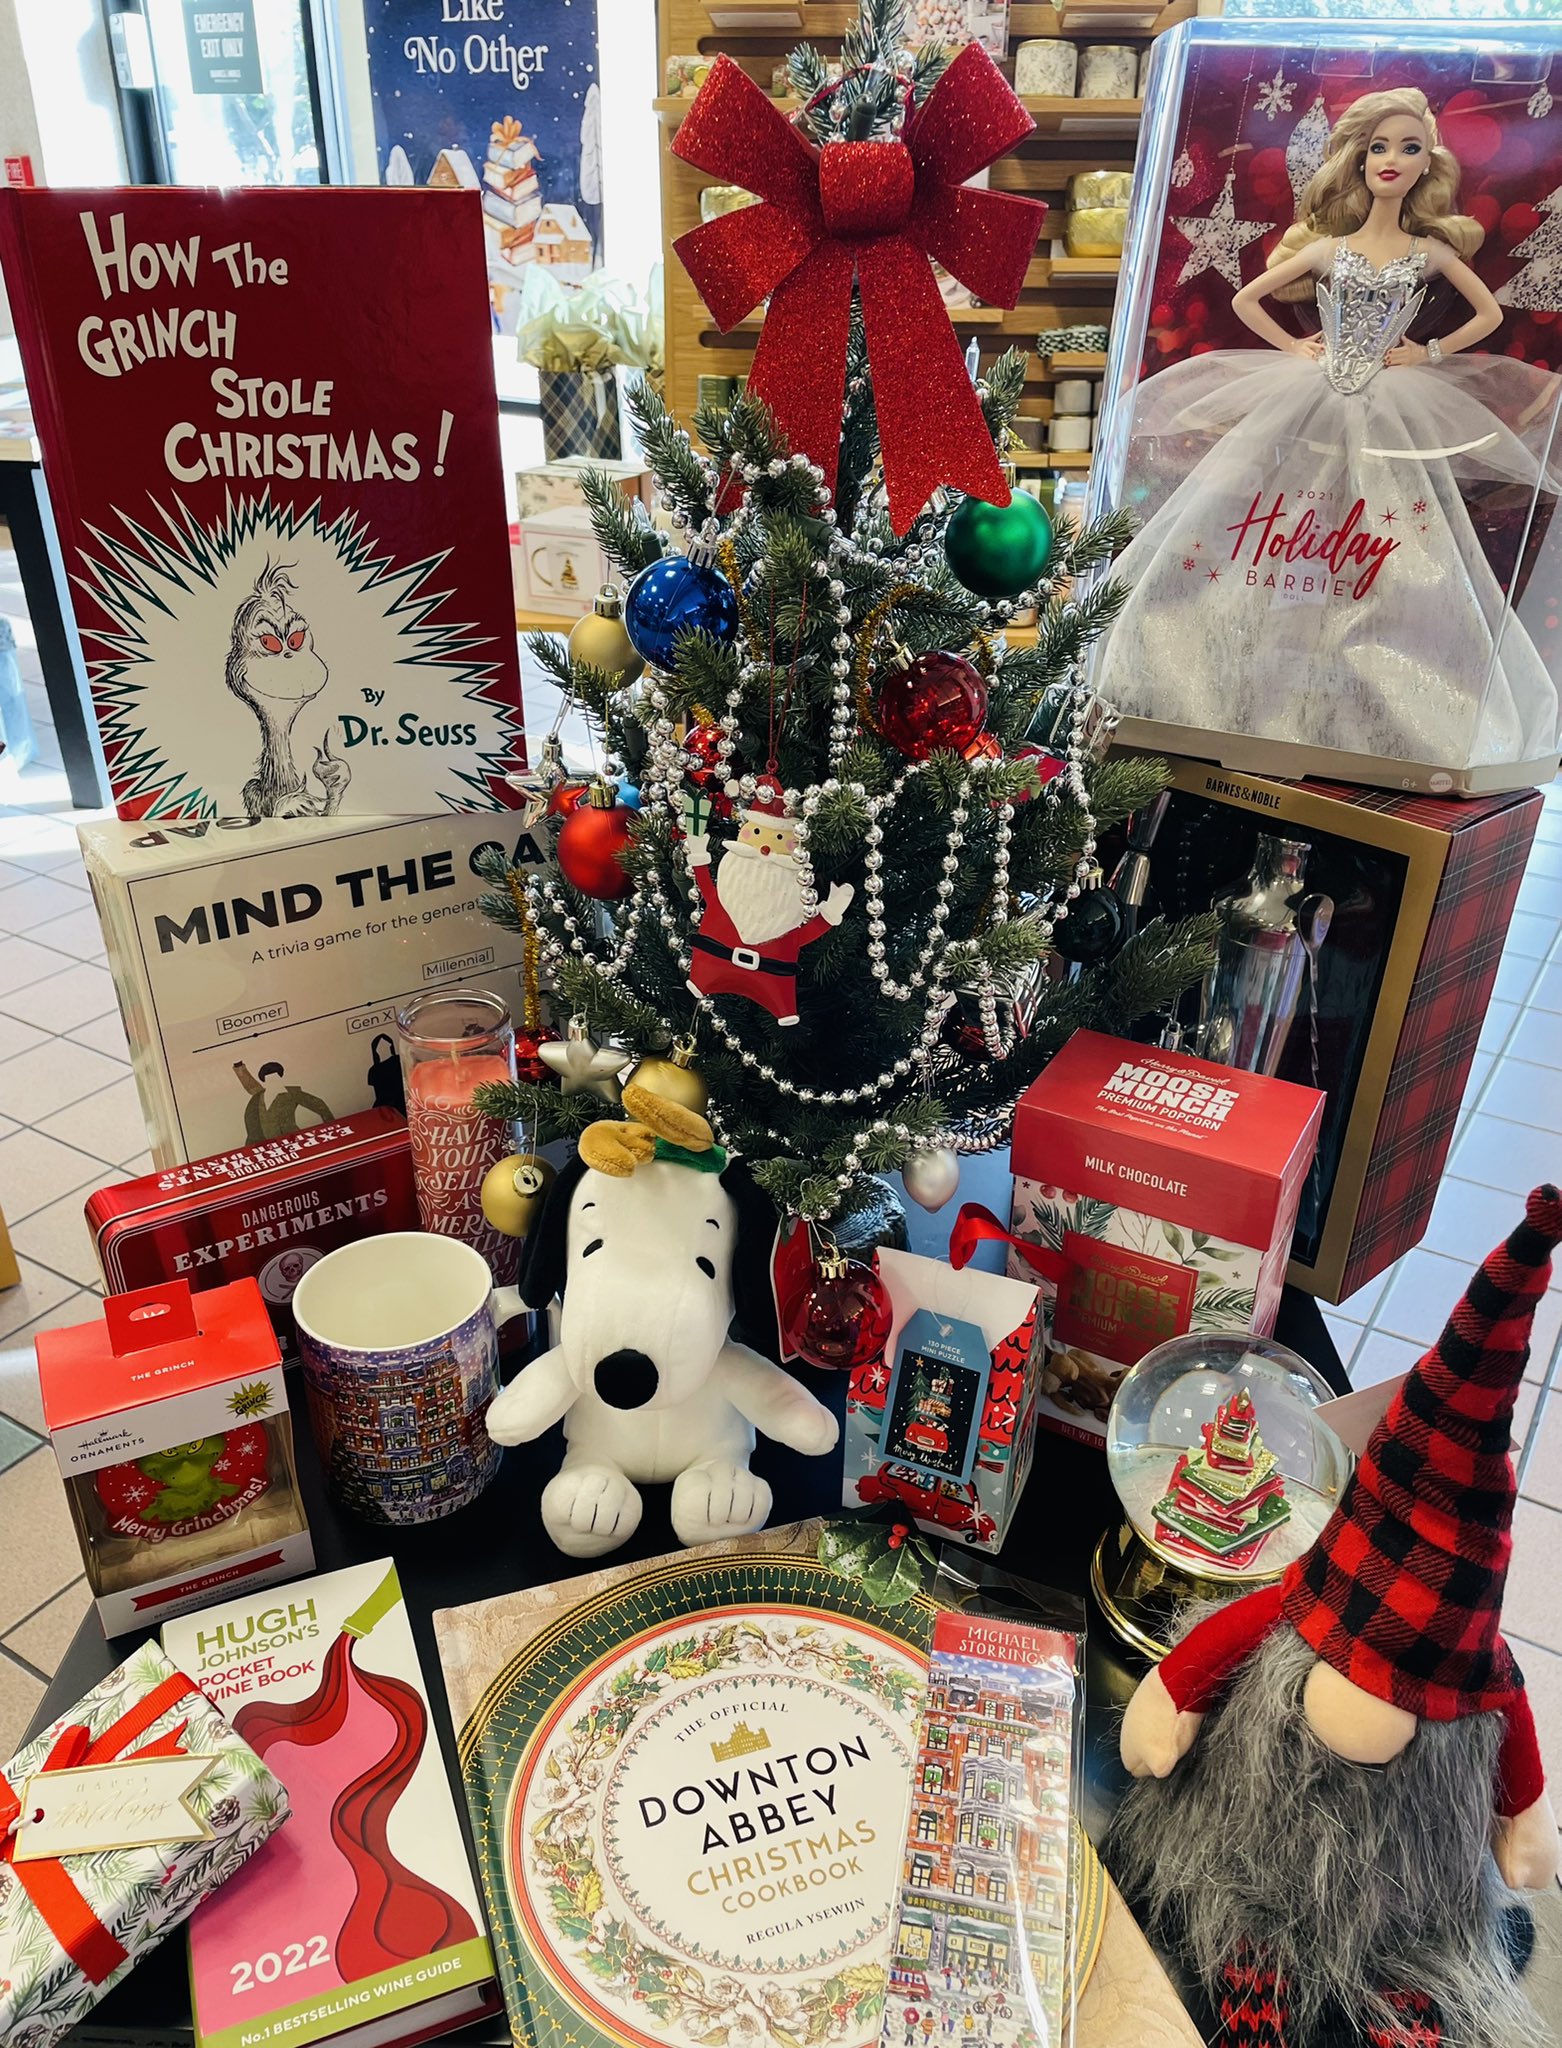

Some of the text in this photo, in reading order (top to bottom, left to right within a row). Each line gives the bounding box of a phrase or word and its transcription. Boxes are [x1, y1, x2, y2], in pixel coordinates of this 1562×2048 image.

[441, 0, 505, 22] Like
[404, 34, 549, 90] No Other
[211, 241, 289, 289] The
[77, 306, 237, 378] GRINCH
[210, 366, 334, 419] STOLE
[1296, 489, 1334, 501] 2021
[1227, 491, 1401, 600] Holiday
[361, 688, 385, 707] By
[338, 713, 477, 748] Dr. Seuss
[1401, 778, 1417, 789] 6+
[154, 883, 323, 954] MIND
[335, 850, 456, 908] THE
[252, 950, 265, 965] A
[268, 940, 309, 960] trivia
[314, 928, 362, 951] game
[366, 921, 387, 937] for
[391, 910, 418, 930] the
[426, 951, 490, 976] Millennial
[222, 1006, 283, 1031] Boomer
[351, 1009, 393, 1031] Gen X
[1103, 1075, 1231, 1122] MUNCH
[1113, 1062, 1240, 1107] MOOSE
[1095, 1105, 1107, 1113] The
[1097, 1090, 1222, 1132] PREMIUM POPCORN
[430, 1112, 491, 1146] HAVE
[158, 1125, 355, 1191] EXPERIMENTS
[162, 1129, 317, 1181] AFTER DINNER
[229, 1152, 299, 1179] DANGEROUS
[431, 1138, 500, 1168] YOUR
[1084, 1155, 1189, 1198] MILK CHOCOLATE
[241, 1190, 320, 1229] DANGEROUS
[447, 1192, 471, 1213] A
[173, 1188, 389, 1273] EXPERIMENTS
[921, 1345, 965, 1364] MINI PUZZLE
[928, 1339, 961, 1355] 130 PIECE
[131, 1360, 195, 1382] THE GRINCH
[235, 1392, 267, 1416] GRINCH
[70, 1437, 145, 1462] ORNAMENTS
[78, 1428, 132, 1450] Hallmark
[1061, 1423, 1077, 1436] NET
[1078, 1430, 1091, 1442] WT
[112, 1477, 267, 1543] Merry Grinchmas!
[180, 1583, 199, 1593] THE
[201, 1569, 239, 1586] GRINCH
[196, 1598, 317, 1655] HUGH
[968, 1626, 1041, 1652] MICHAEL
[197, 1624, 320, 1672] JOHNSON'S
[959, 1639, 1046, 1665] STORRINGS
[198, 1656, 275, 1691] POCKET
[258, 1660, 316, 1688] BOOK
[674, 1701, 789, 1743] THE OFFICIAL
[638, 1735, 871, 1829] DOWNTON
[702, 1784, 837, 1856] ABBEY
[687, 1819, 876, 1896] CHRISTMAS
[722, 1856, 864, 1914] COOKBOOK
[746, 1897, 866, 1944] REGULA YSEWIJN
[230, 1935, 331, 1996] 2022
[241, 1957, 462, 2047] No.1 BESTSELLING WINE GUIDE
